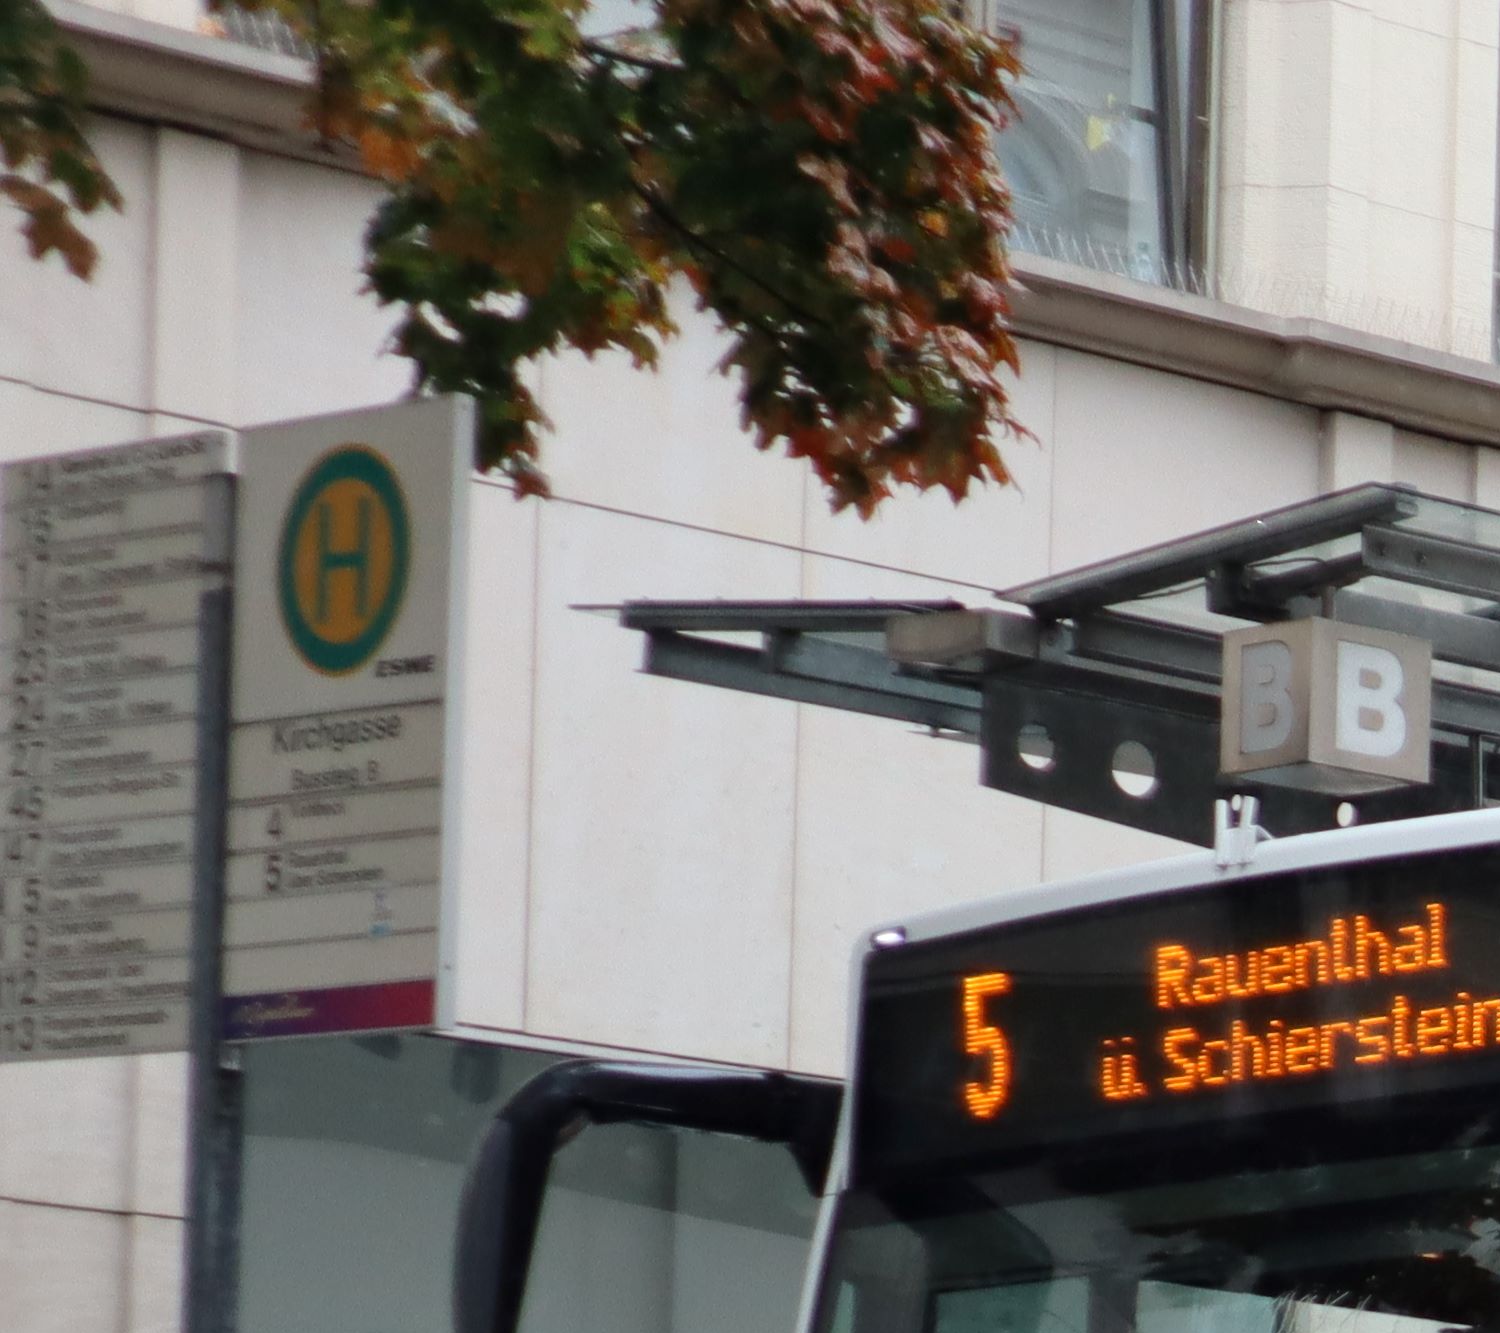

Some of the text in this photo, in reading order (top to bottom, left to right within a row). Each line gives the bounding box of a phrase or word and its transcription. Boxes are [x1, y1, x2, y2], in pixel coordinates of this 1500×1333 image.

[317, 498, 368, 625] H
[271, 714, 403, 754] Kirchgasse
[1240, 639, 1293, 755] B
[1335, 639, 1406, 757] B
[266, 808, 283, 839] 4
[266, 853, 282, 892] 5
[1155, 901, 1451, 1010] Rauenthal
[963, 970, 1013, 1120] 5
[1101, 1035, 1149, 1101] ü.
